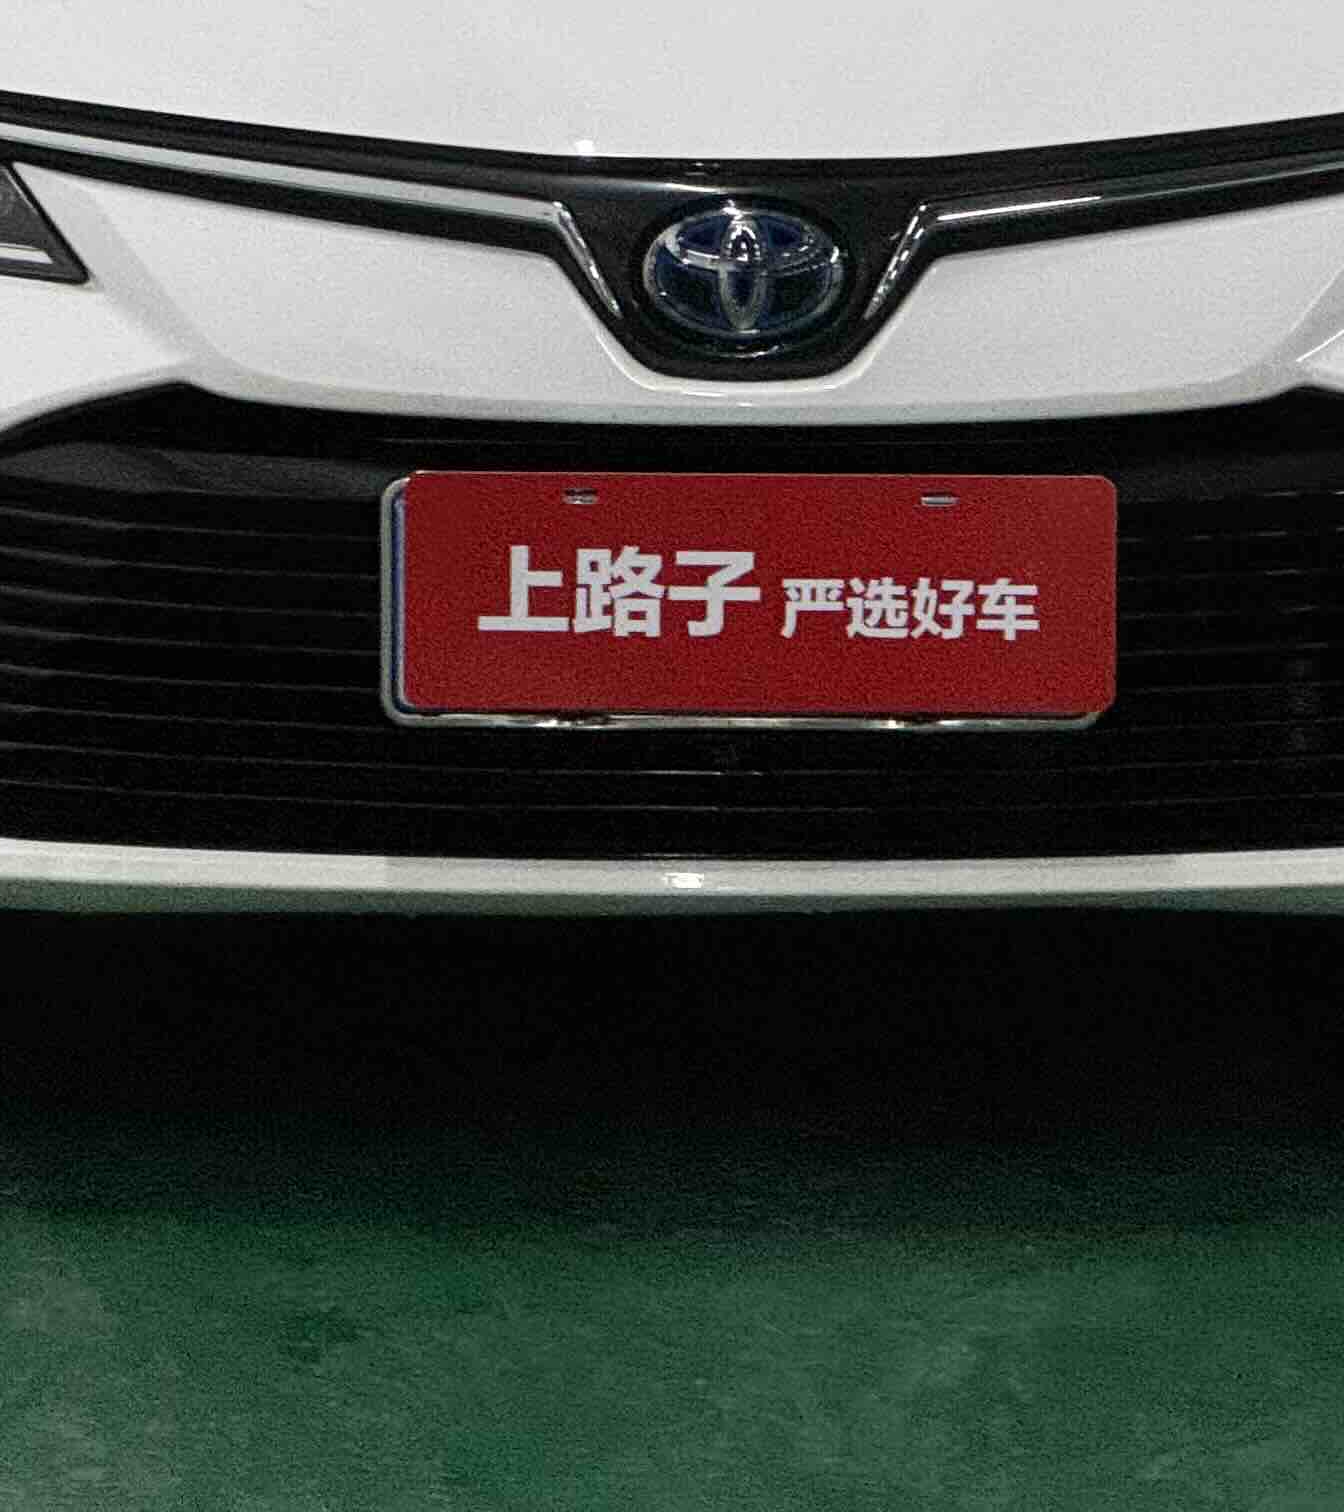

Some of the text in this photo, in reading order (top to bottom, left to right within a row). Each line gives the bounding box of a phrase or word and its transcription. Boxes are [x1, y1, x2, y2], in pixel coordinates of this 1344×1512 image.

[477, 545, 1040, 641] 上路子 严选好车
